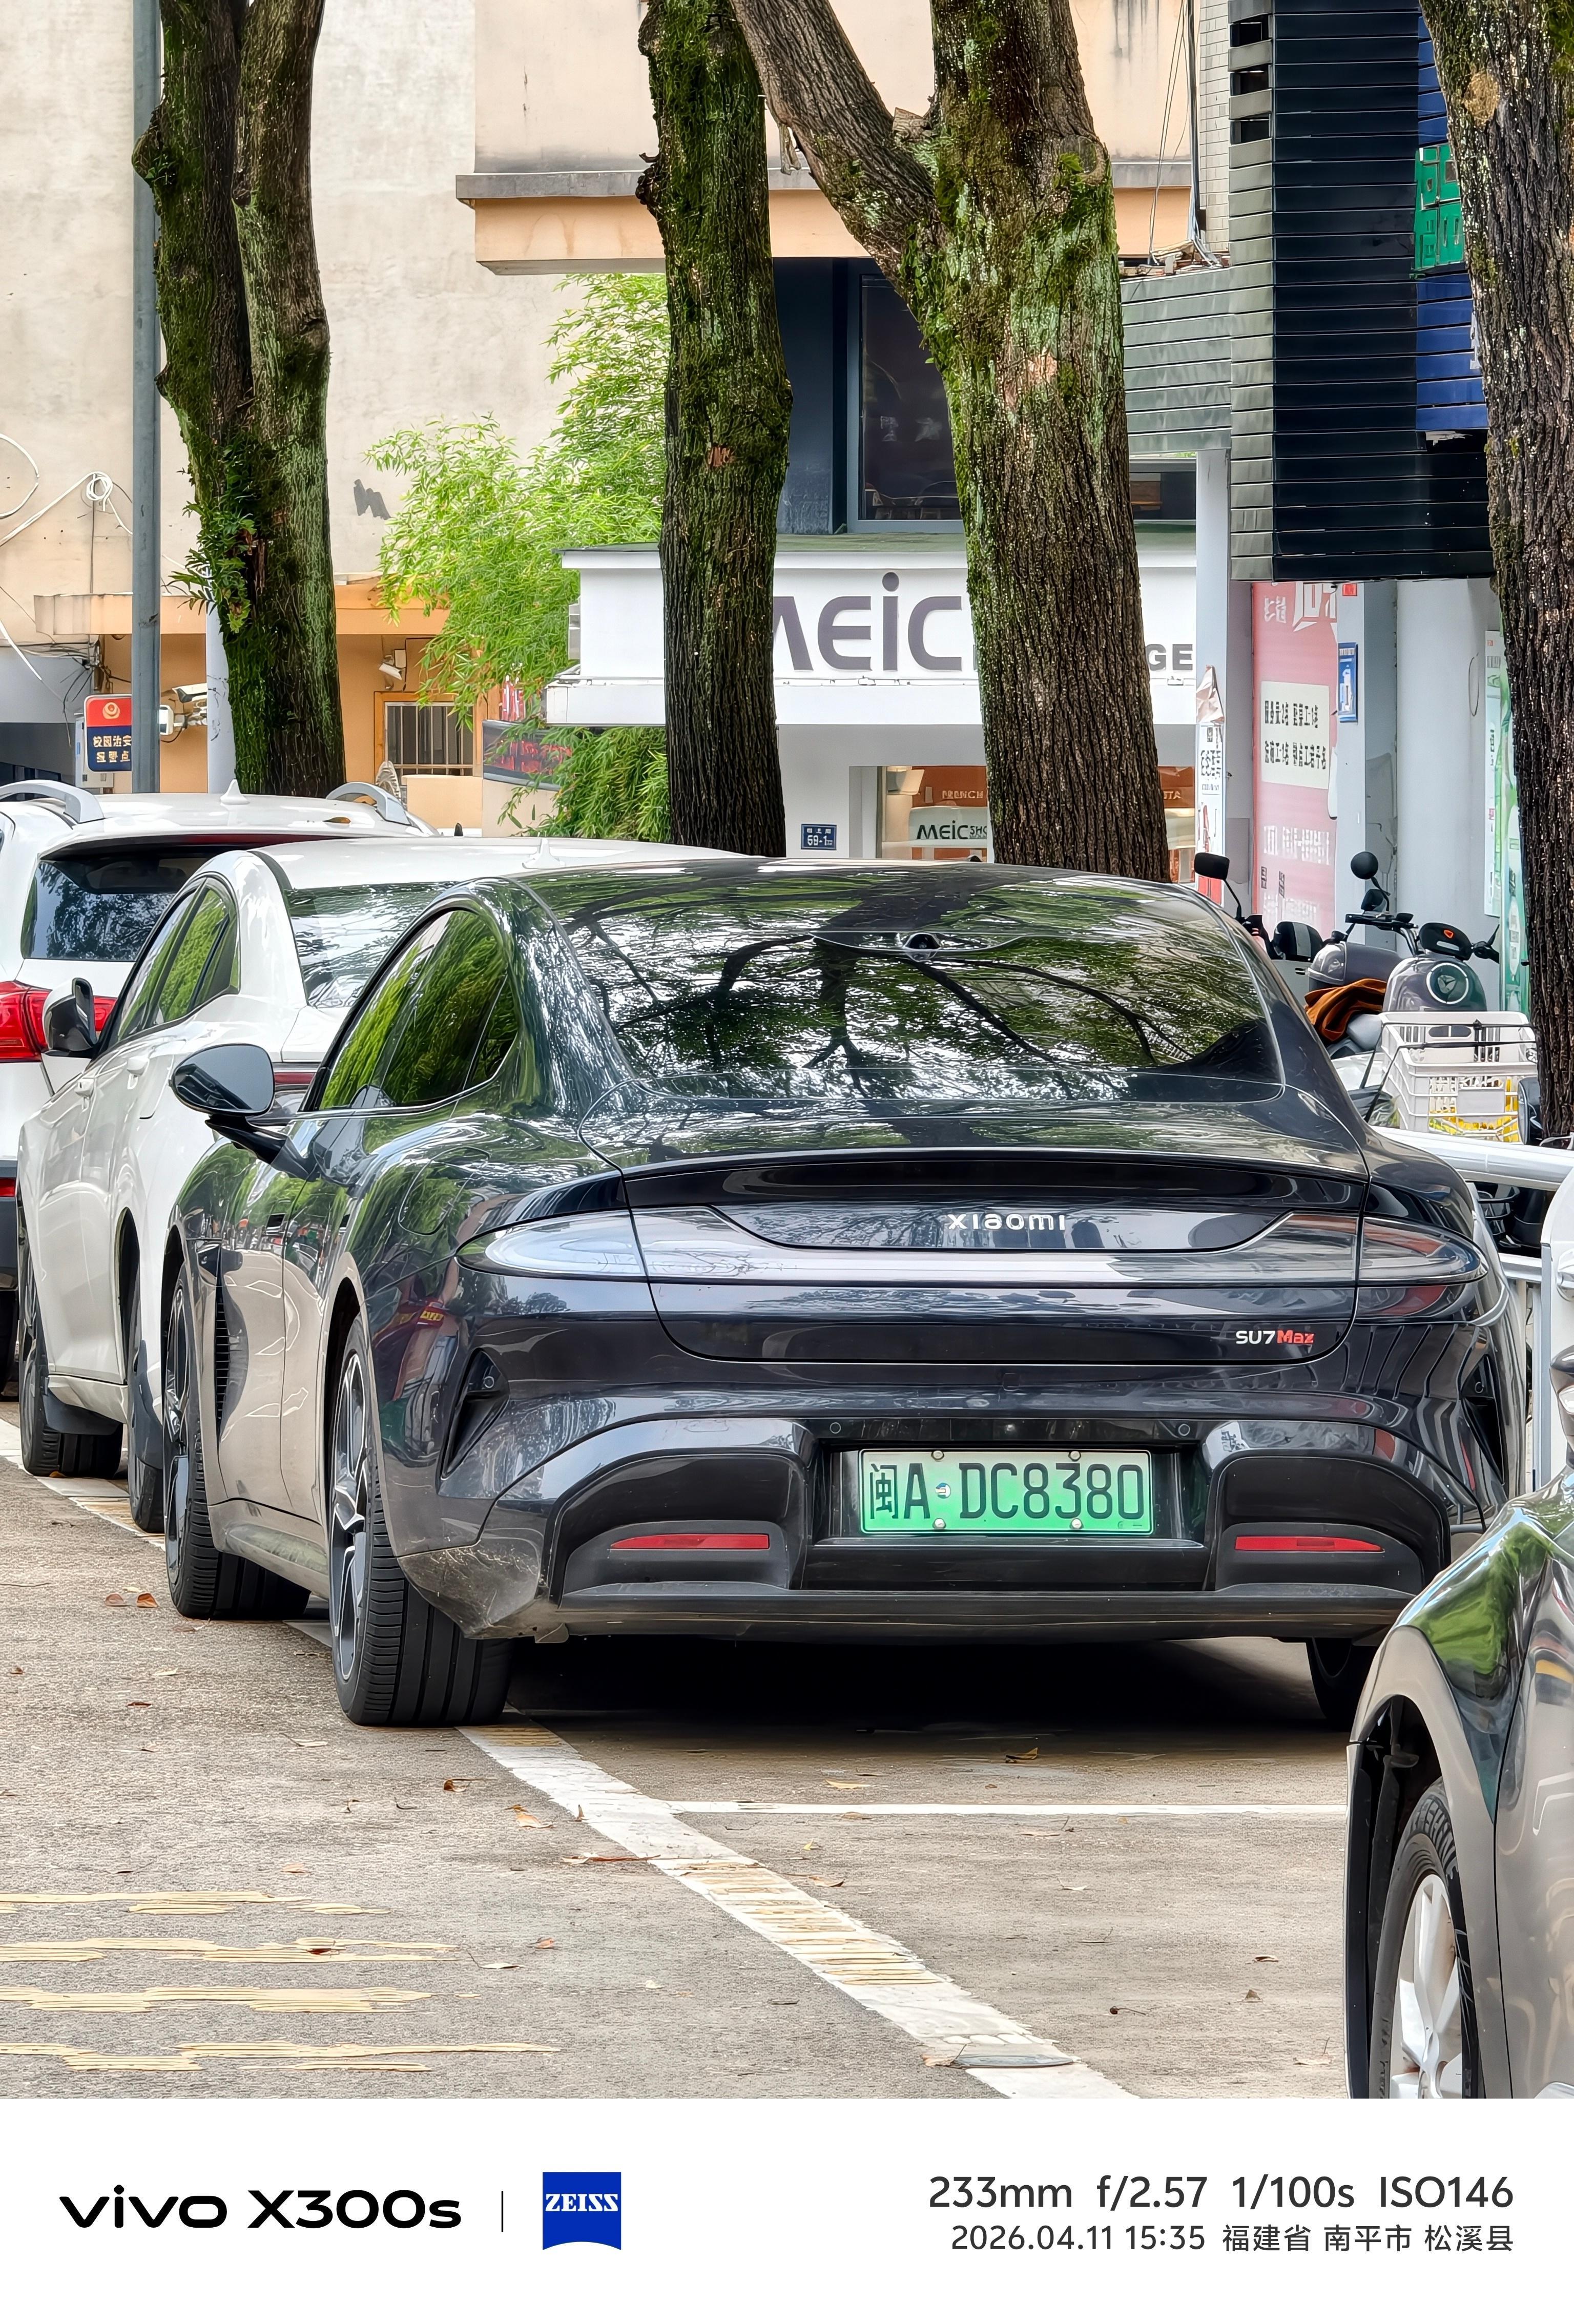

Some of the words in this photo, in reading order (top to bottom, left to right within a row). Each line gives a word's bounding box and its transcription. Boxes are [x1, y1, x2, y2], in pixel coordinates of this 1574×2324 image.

[1146, 644, 1193, 671] GE
[1236, 1331, 1276, 1344] SU7
[1277, 1330, 1314, 1344] Max
[870, 1463, 931, 1520] 闽A
[959, 1462, 1144, 1520] DC8380
